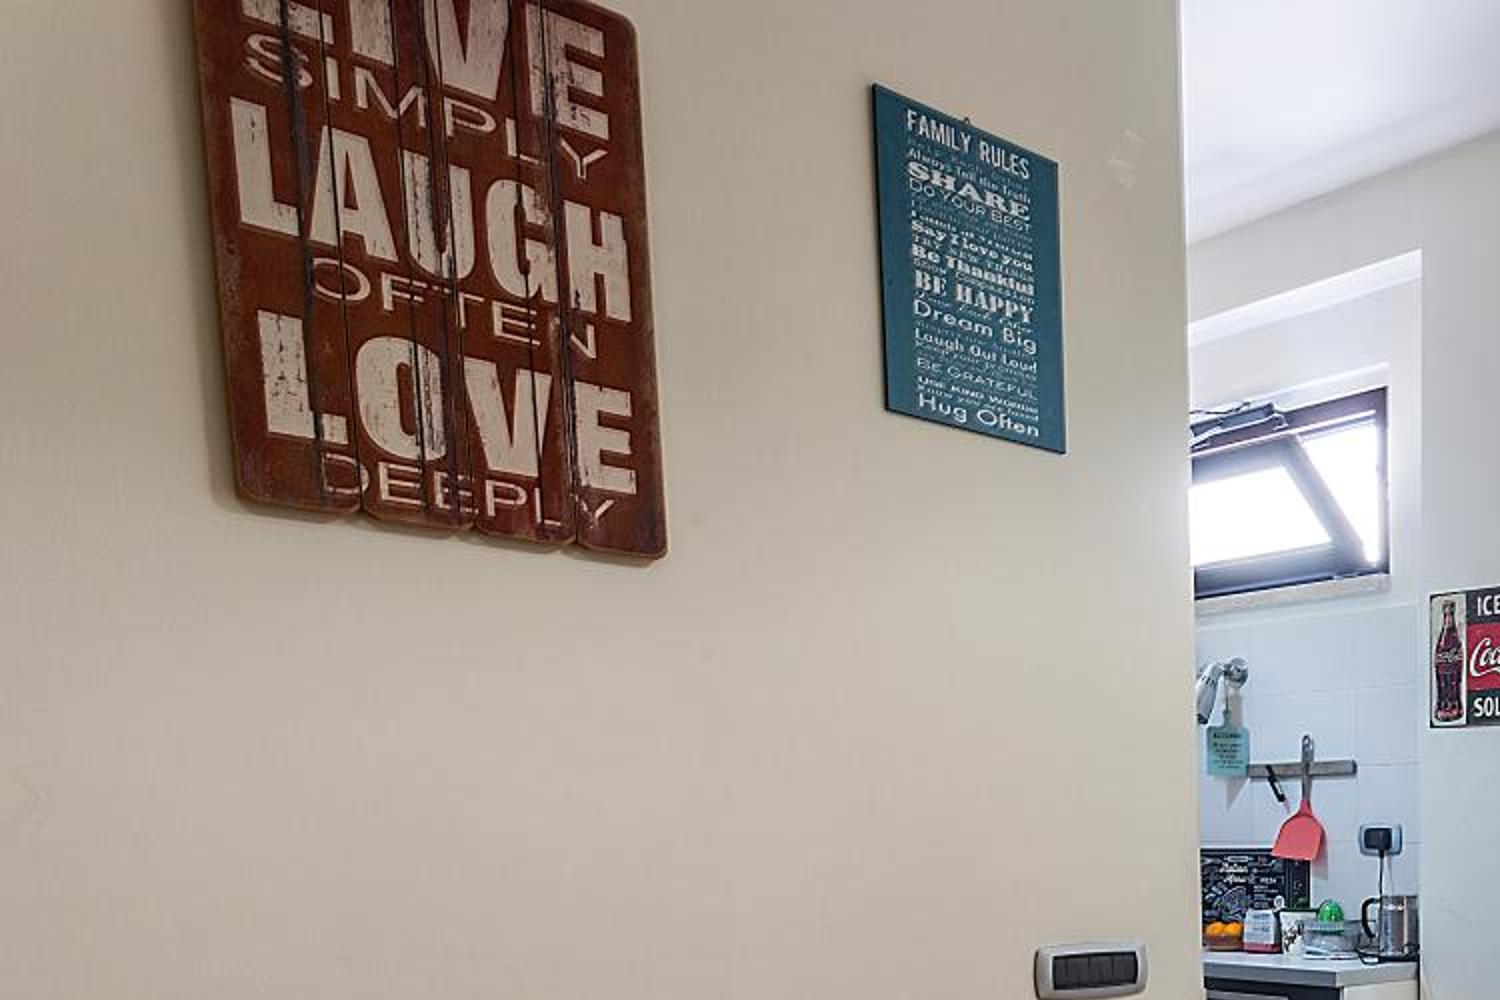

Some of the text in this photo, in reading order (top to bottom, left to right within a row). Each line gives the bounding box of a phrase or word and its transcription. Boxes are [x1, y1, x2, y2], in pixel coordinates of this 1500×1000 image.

[240, 0, 609, 139] IVE
[246, 33, 608, 180] SIMPLY
[906, 110, 971, 154] FAMILY
[978, 140, 1030, 179] RULES
[229, 96, 632, 323] LAUGH
[907, 161, 1031, 220] SHARE
[939, 189, 986, 217] YOUR
[991, 209, 1031, 234] BEST
[911, 219, 947, 242] Say
[962, 238, 999, 258] love
[1001, 254, 1033, 272] you
[309, 257, 597, 360] OFTEN
[912, 298, 992, 336] Dream
[1002, 327, 1037, 355] Big
[913, 270, 1034, 325] BE HAPPY
[914, 327, 964, 353] Laugh
[969, 344, 997, 361] Out
[1001, 353, 1037, 372] Loud
[916, 357, 942, 372] BE
[946, 365, 1038, 399] GRATEFUL
[257, 309, 637, 494] LOVE
[918, 393, 1039, 437] Hug Often
[320, 454, 614, 529] DEEPLY
